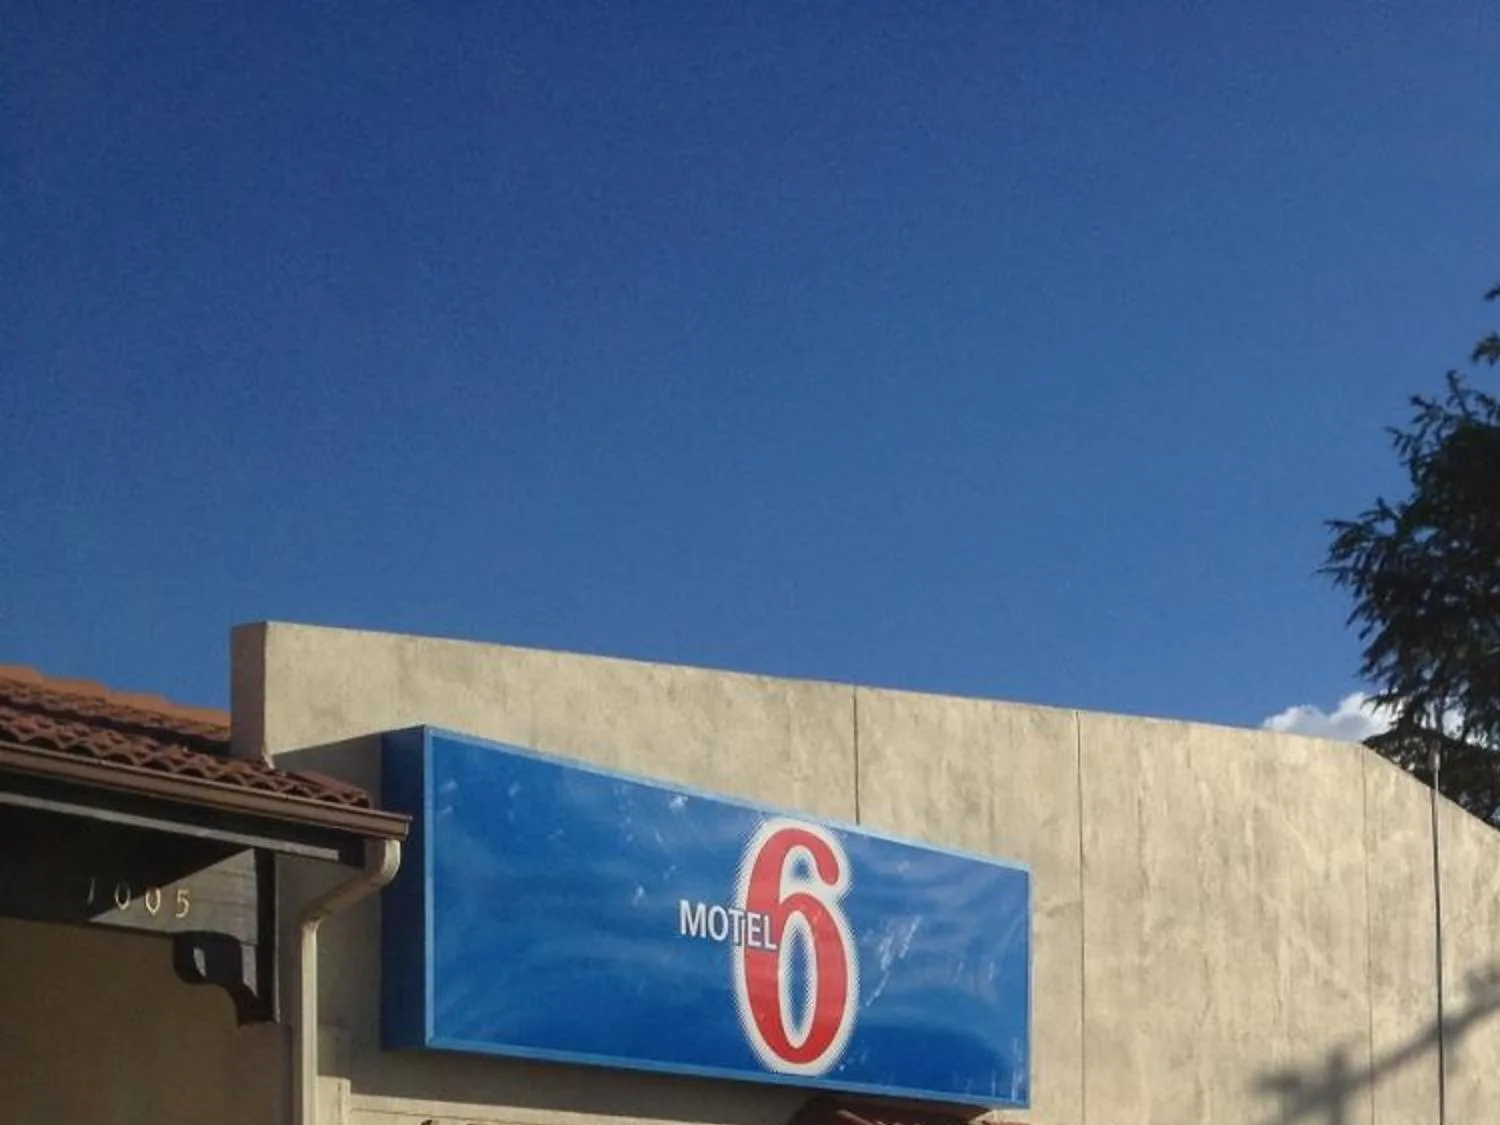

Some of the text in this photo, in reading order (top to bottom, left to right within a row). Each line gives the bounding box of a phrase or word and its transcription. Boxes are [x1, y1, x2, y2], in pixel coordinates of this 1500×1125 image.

[87, 876, 190, 919] 1005
[679, 822, 855, 1071] MOTEL 6
